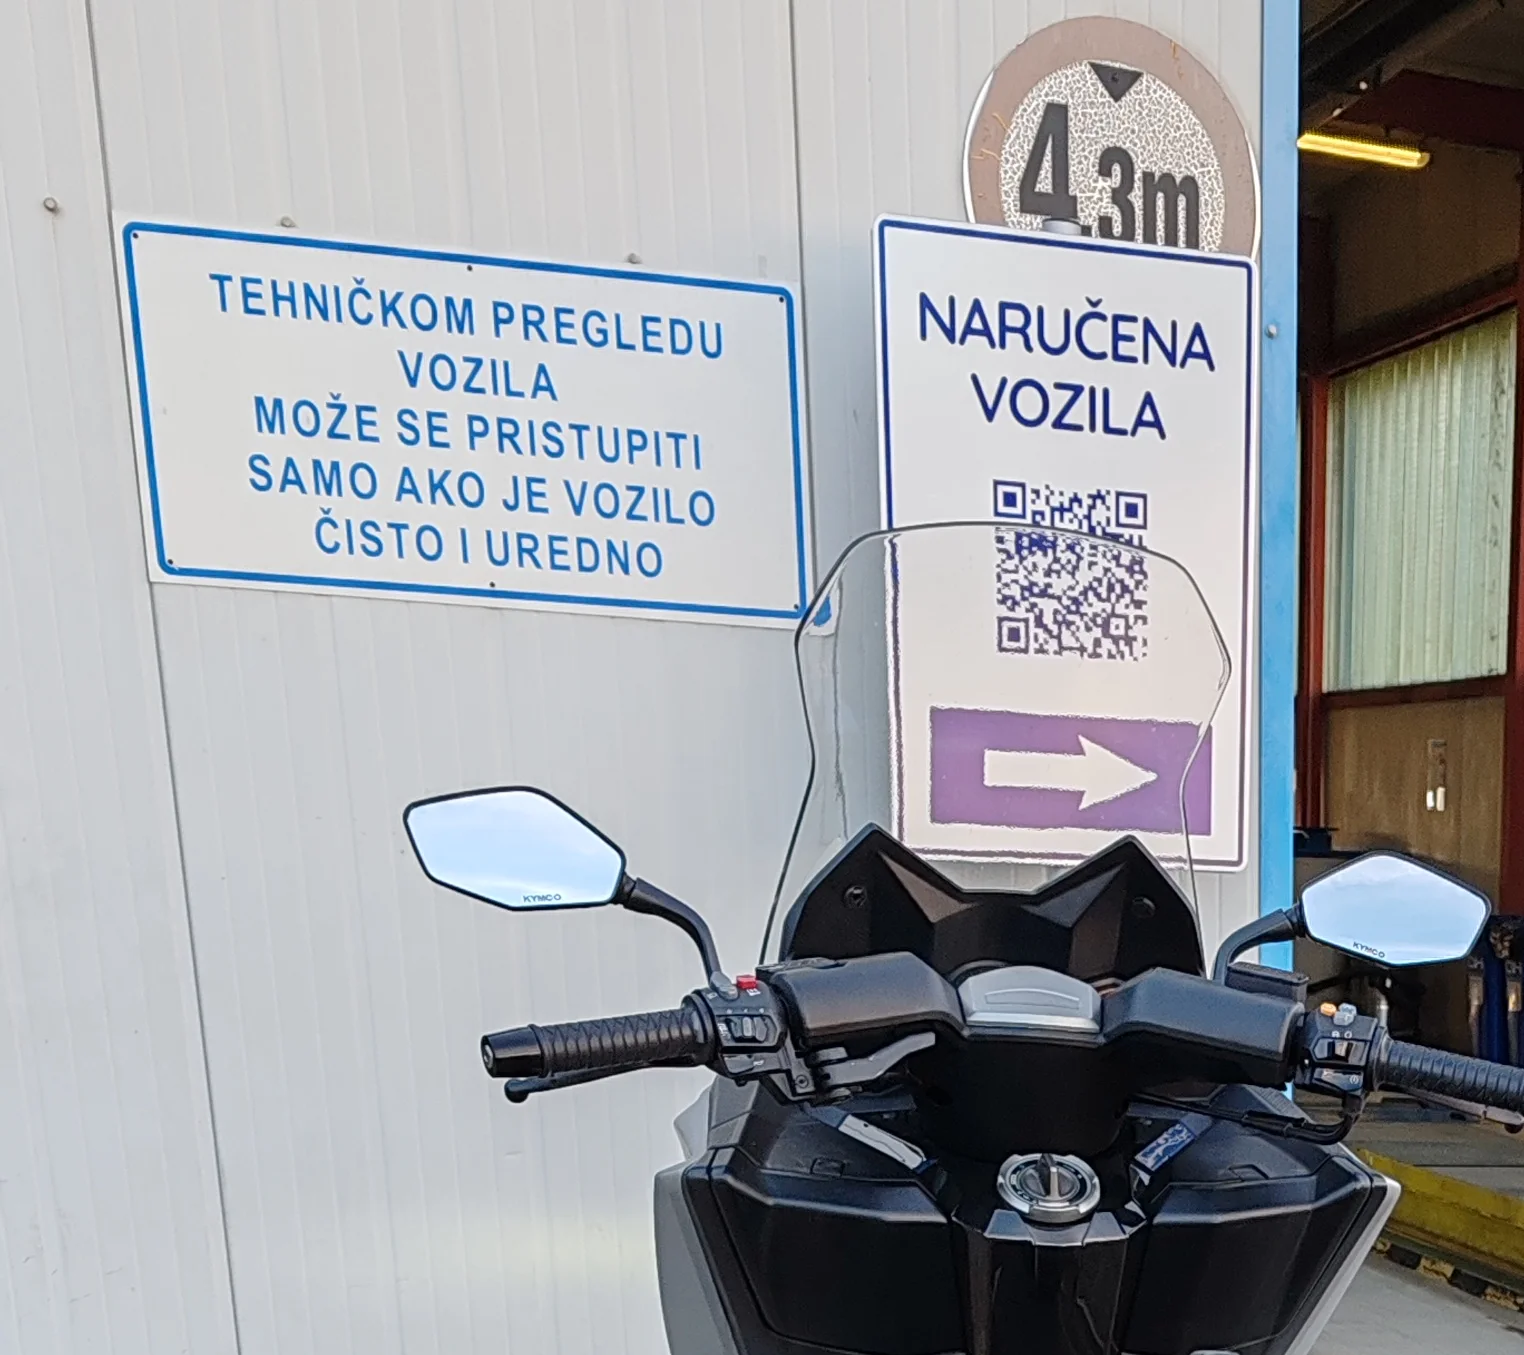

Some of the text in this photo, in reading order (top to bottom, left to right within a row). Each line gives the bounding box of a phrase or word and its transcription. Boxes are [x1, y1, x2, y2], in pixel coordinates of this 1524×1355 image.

[209, 272, 725, 360] TEHNIČKOM PREGLEDU
[918, 292, 1216, 372] NARUČENA
[397, 350, 559, 401] VOZILA
[971, 373, 1167, 441] VOZILA
[254, 393, 703, 471] MOŽE SE PRISTUPITI
[248, 453, 717, 527] SAMO AKO JE VOZILO
[315, 507, 664, 579] ČISTO I UREDNO
[523, 893, 562, 903] KYMCO
[1353, 941, 1386, 958] KYMCO
